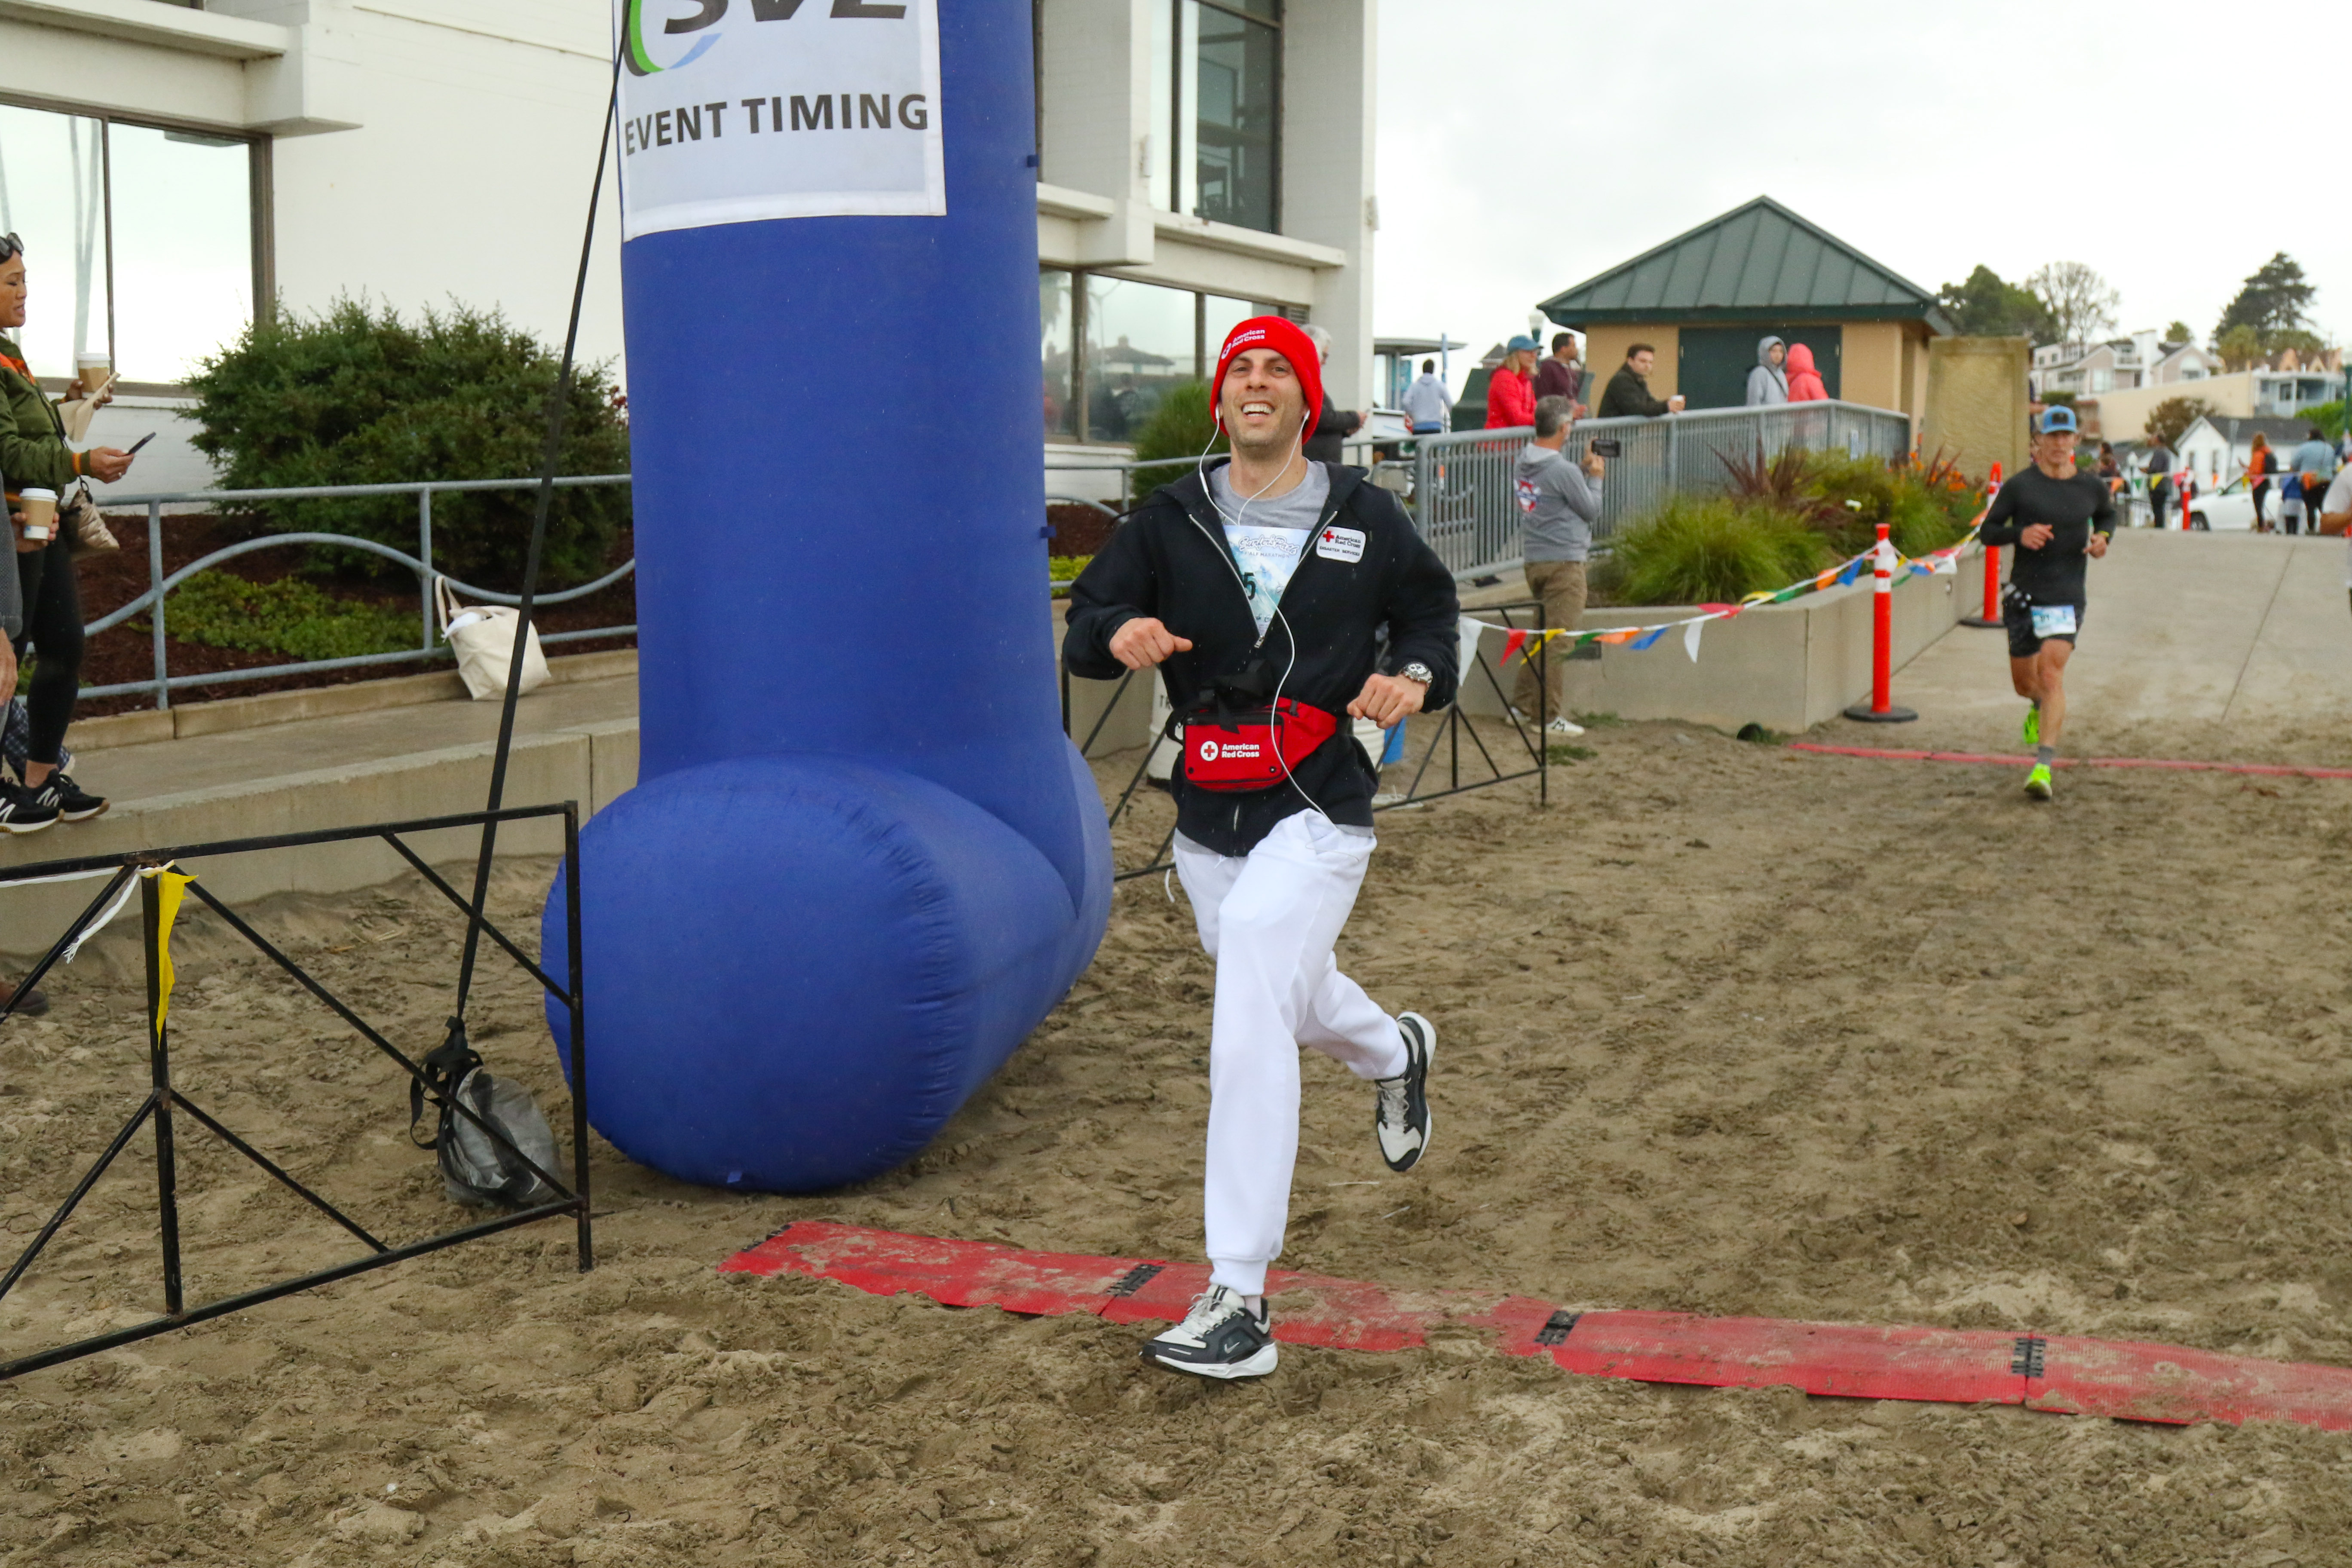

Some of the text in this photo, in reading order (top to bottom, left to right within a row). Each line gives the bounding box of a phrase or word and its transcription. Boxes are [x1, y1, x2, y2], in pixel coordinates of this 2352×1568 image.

[625, 93, 928, 156] EVENT TIMING
[1232, 329, 1265, 343] American
[1231, 338, 1243, 348] Red
[1336, 535, 1361, 543] American
